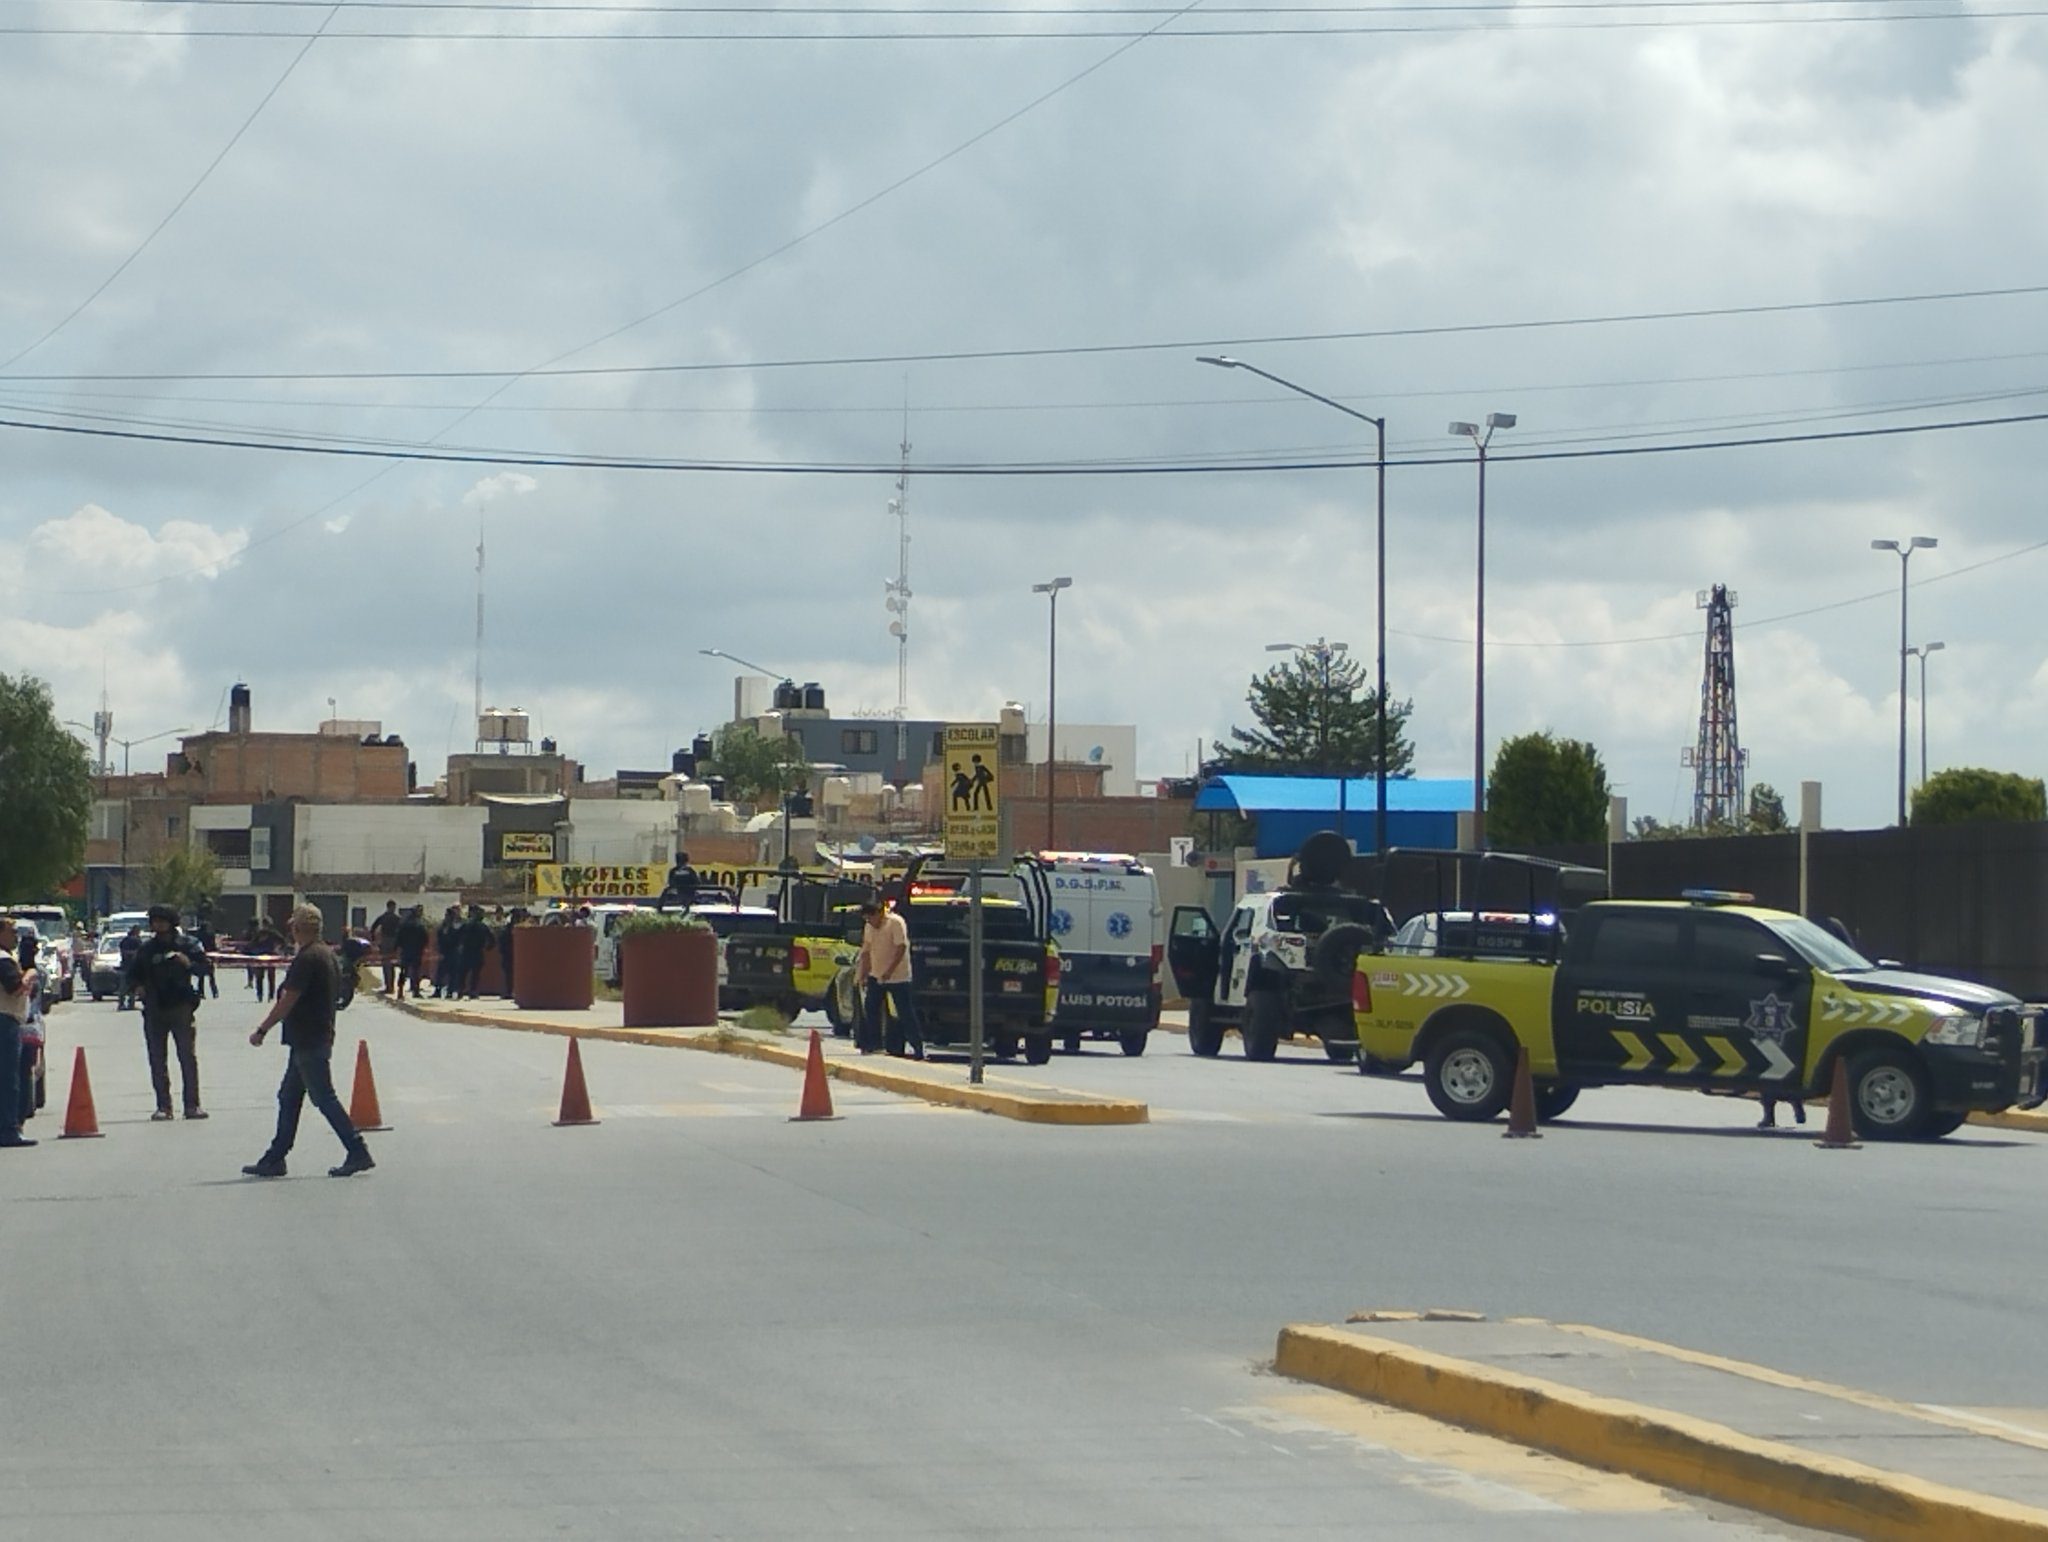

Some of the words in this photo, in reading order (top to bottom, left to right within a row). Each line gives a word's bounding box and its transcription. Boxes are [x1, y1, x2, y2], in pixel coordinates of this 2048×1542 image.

[947, 727, 995, 741] ESCOLAR
[561, 866, 648, 882] MOFLES
[1061, 994, 1093, 1006] LUIS
